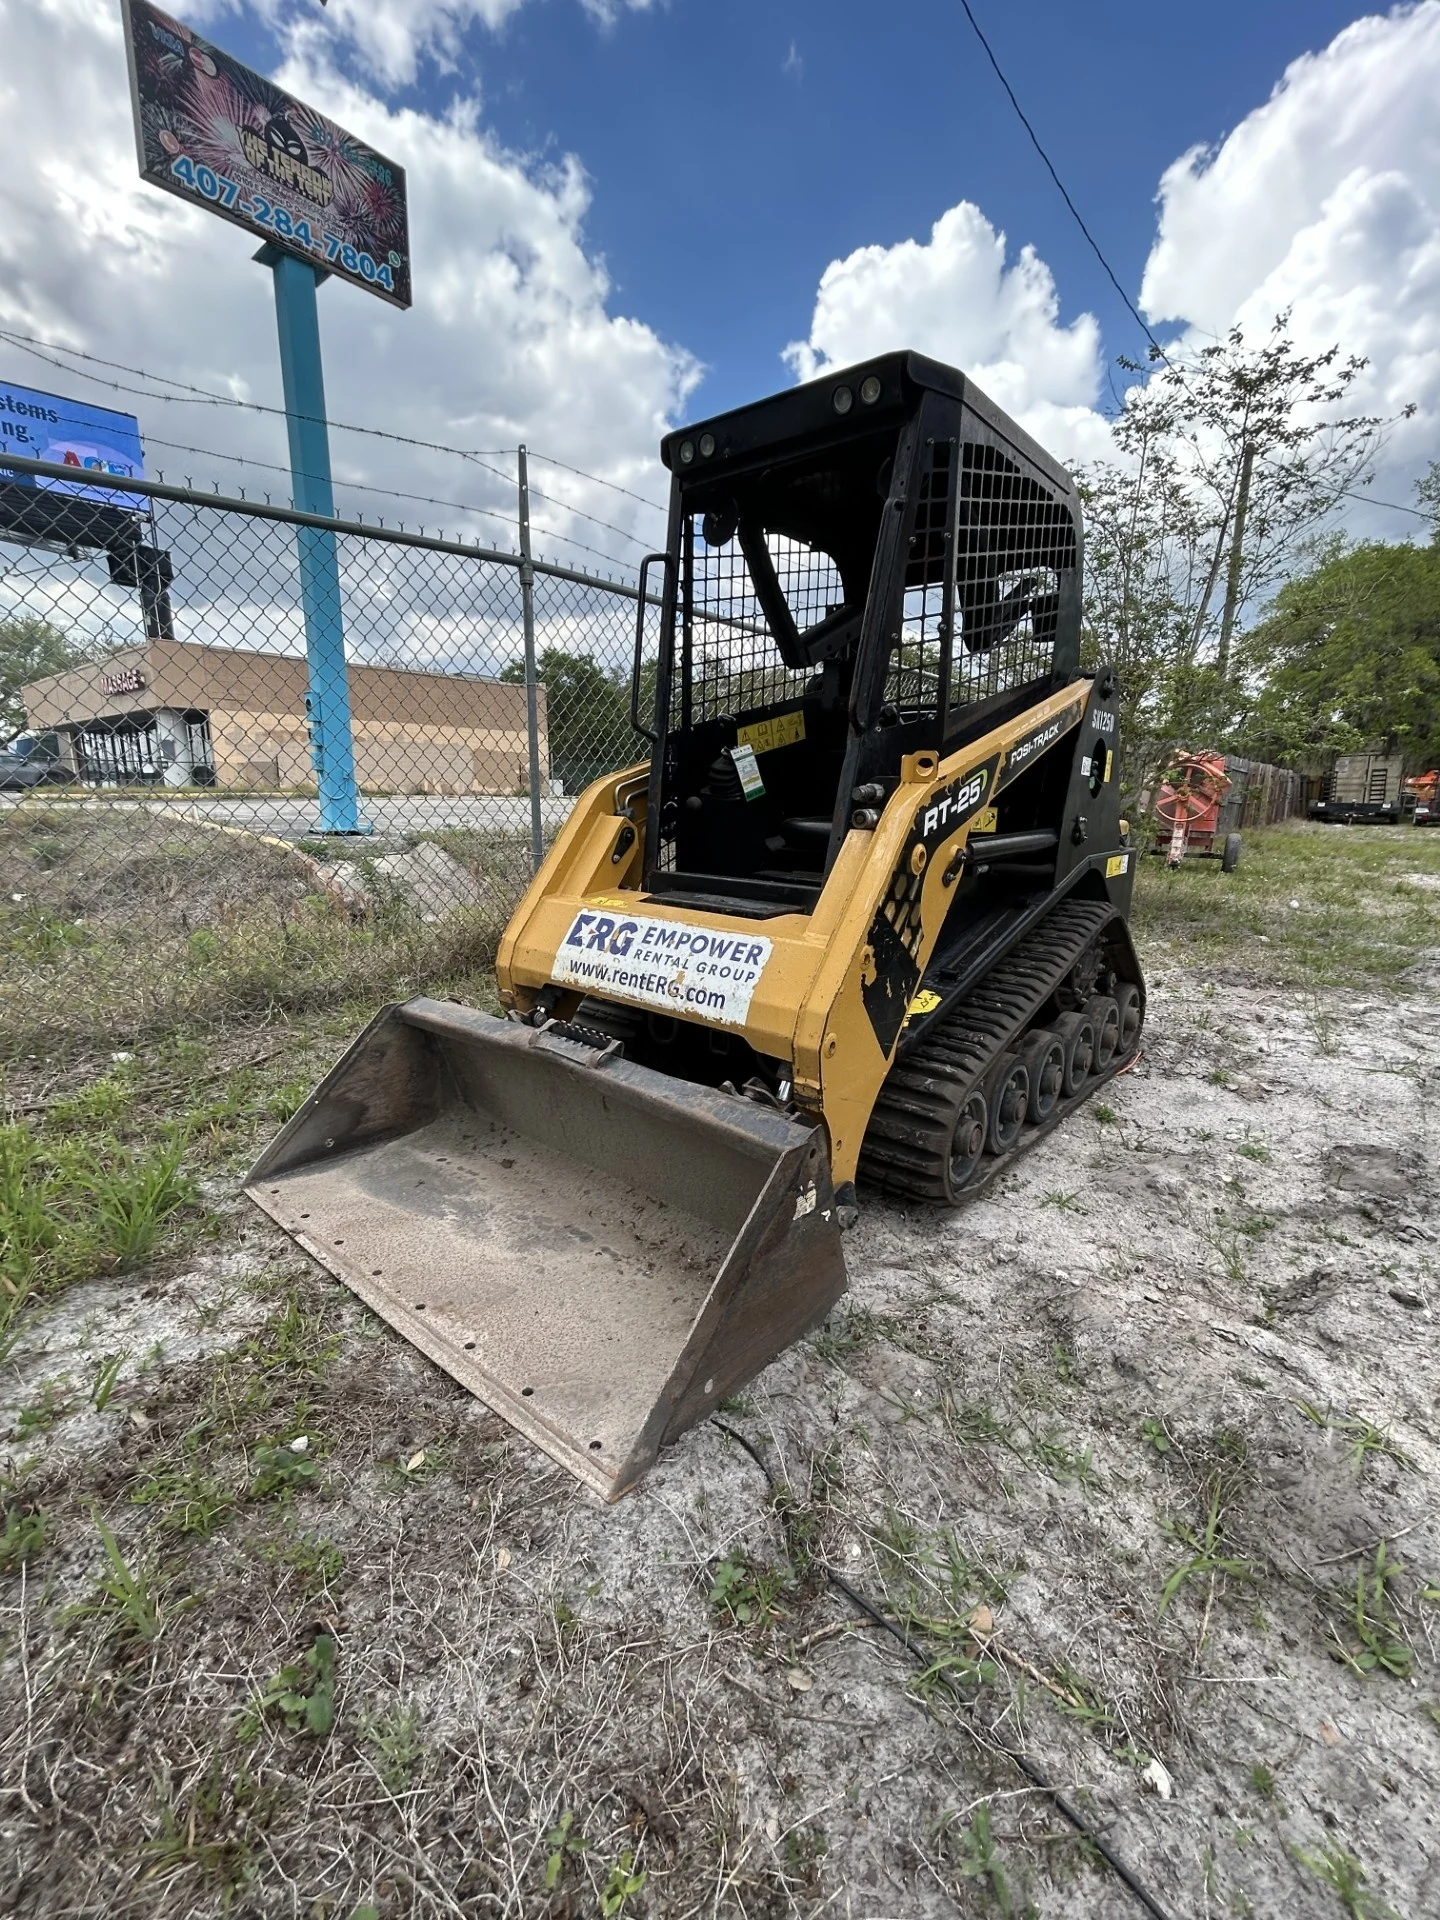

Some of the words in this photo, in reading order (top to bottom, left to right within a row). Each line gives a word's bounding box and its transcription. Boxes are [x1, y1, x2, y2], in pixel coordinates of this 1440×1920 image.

[148, 21, 185, 57] VISA
[235, 124, 268, 158] THE
[270, 146, 333, 191] TERROR
[245, 145, 264, 170] OF
[266, 157, 295, 185] THE
[297, 175, 332, 208] TENT
[171, 154, 394, 291] 407-284-7804
[1010, 722, 1060, 768] POSI-TRACK
[923, 777, 981, 837] RT-25
[566, 913, 638, 957] ERG
[641, 926, 764, 966] EMPOWER
[569, 959, 726, 1010] www.rentERG.com
[633, 949, 690, 971] RENTAL
[696, 961, 756, 983] GROUP
